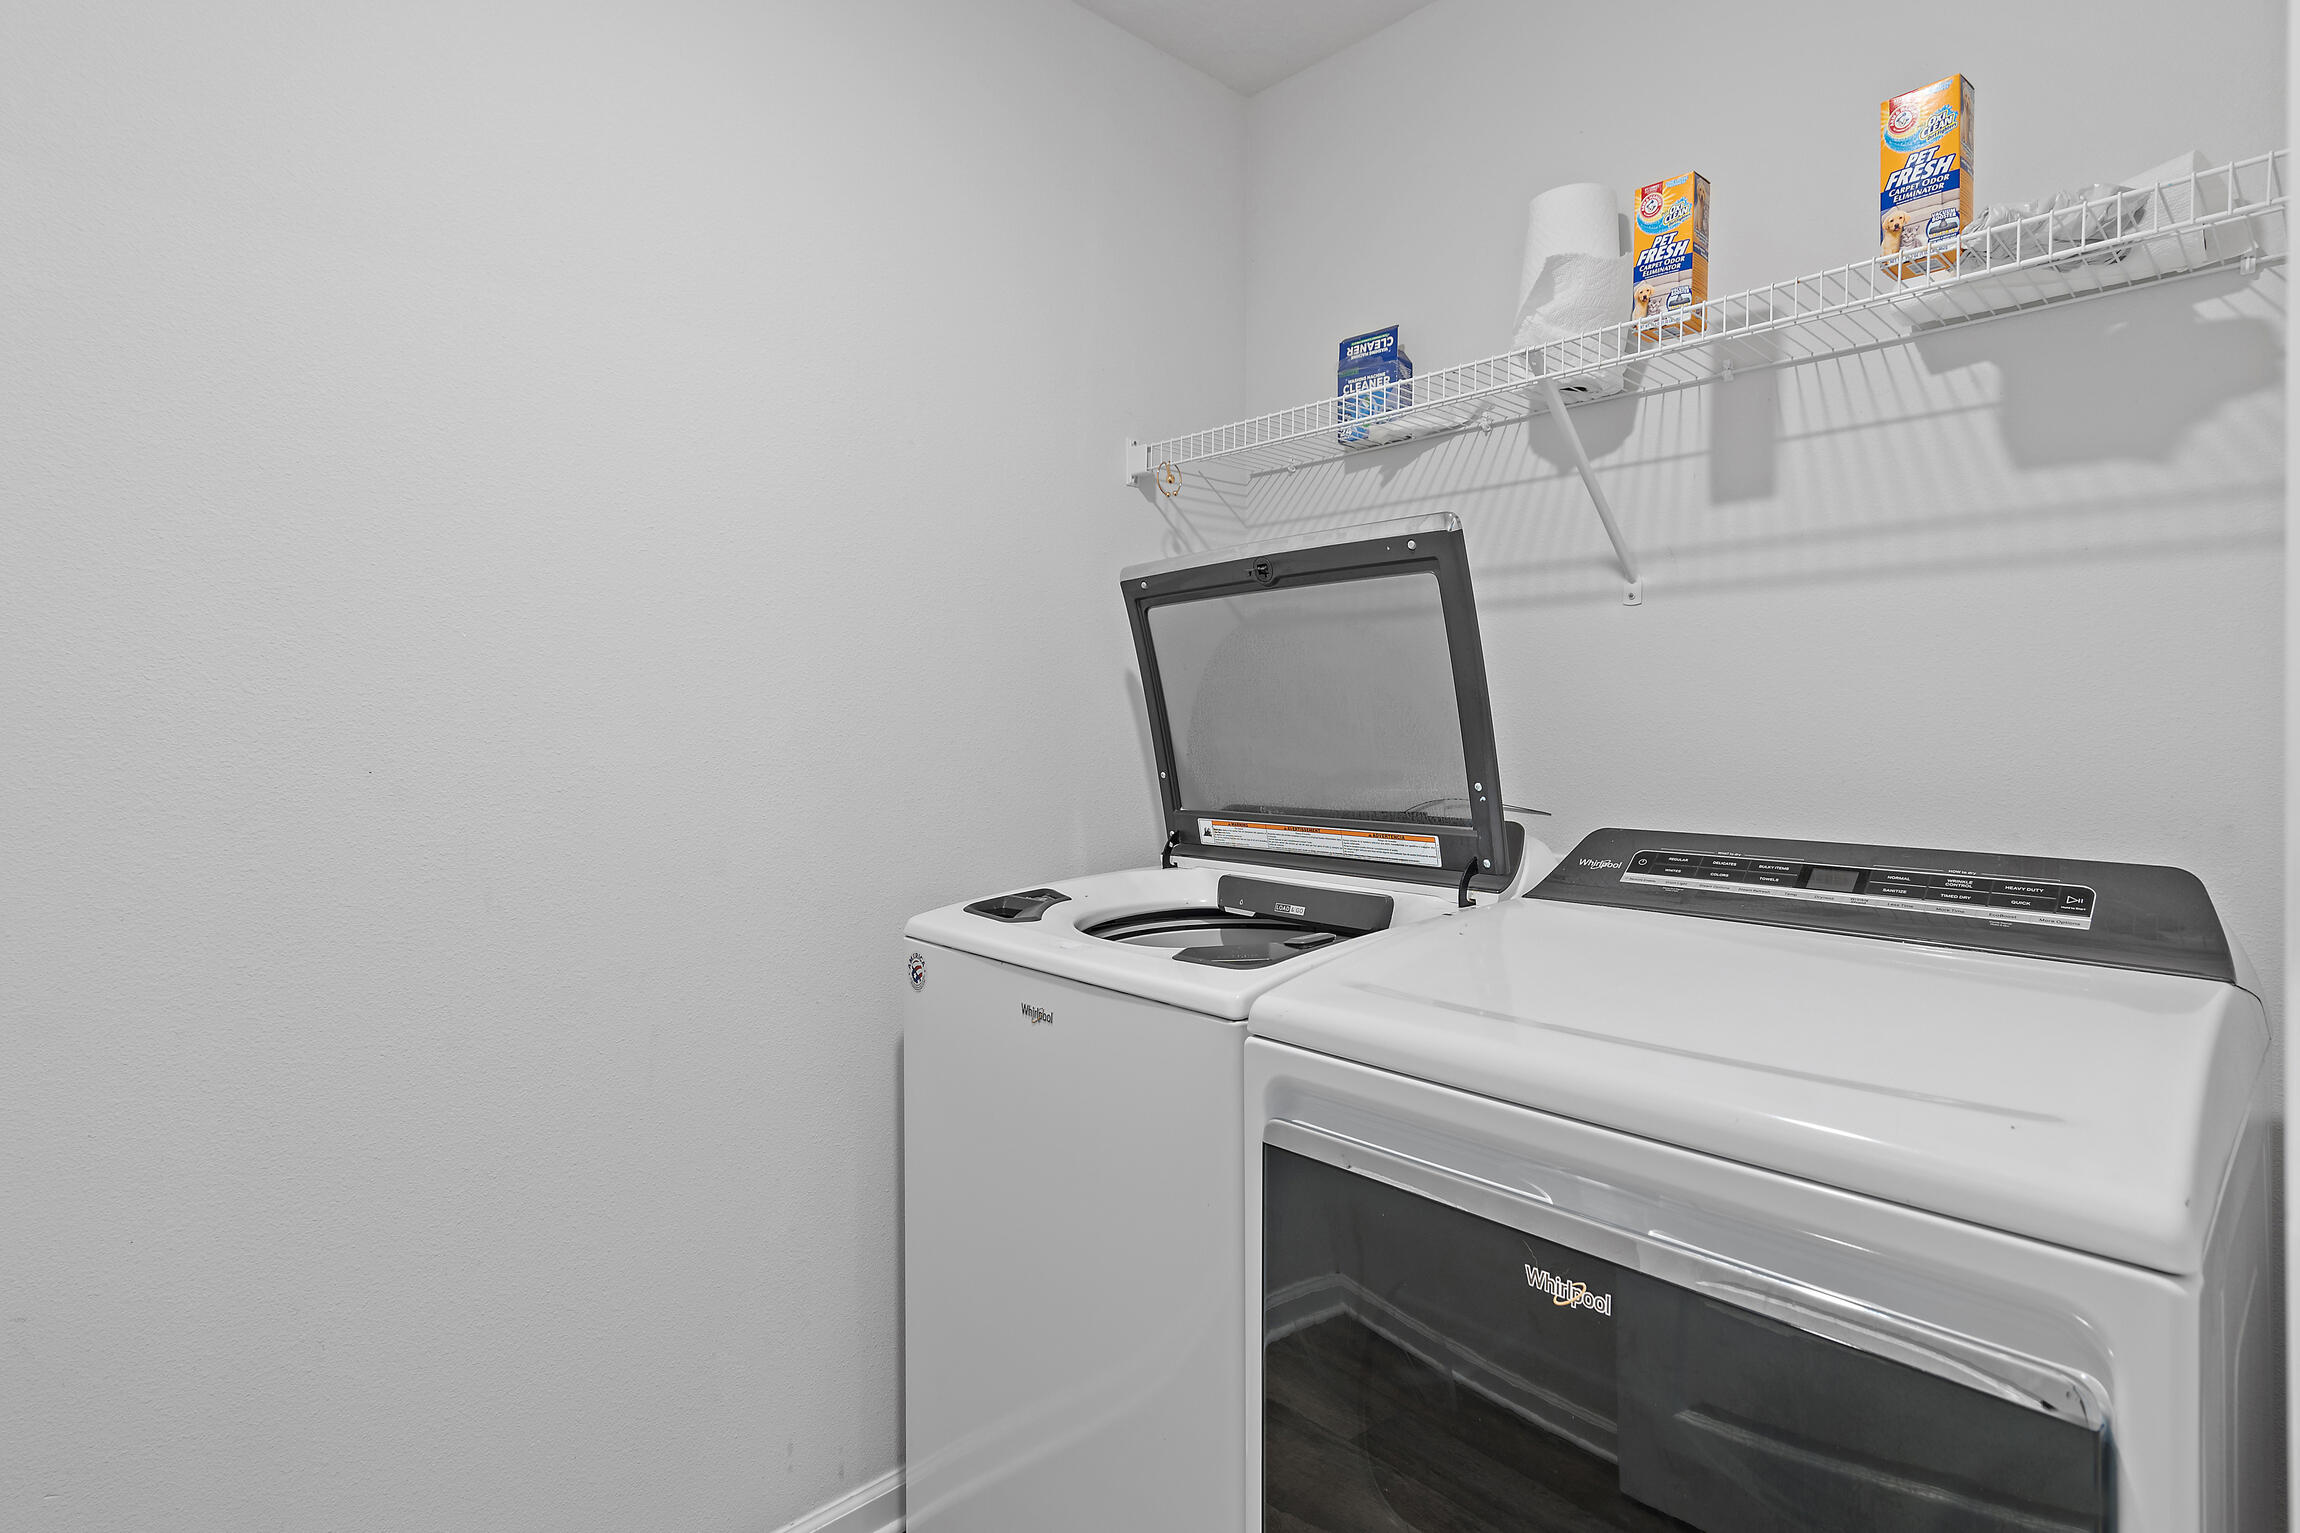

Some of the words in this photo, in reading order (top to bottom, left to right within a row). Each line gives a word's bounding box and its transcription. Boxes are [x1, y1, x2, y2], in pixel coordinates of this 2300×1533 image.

[1921, 114, 1955, 139] CLEAN
[1928, 111, 1947, 126] OXI
[1905, 146, 1940, 168] PET
[1885, 154, 1956, 191] FRESH
[1889, 182, 1921, 197] CARPET
[1922, 173, 1950, 187] ODOR
[1893, 182, 1945, 203] ELIMINATOR
[1664, 206, 1688, 224] CLEAN
[1652, 231, 1678, 248] PET
[1636, 239, 1690, 267] FRESH
[1639, 260, 1663, 272] CARPET
[1664, 256, 1686, 266] ODOR
[1642, 262, 1682, 277] ELIMINATOR
[1346, 336, 1394, 357] CLEANER
[1343, 376, 1391, 394] CLEANER
[1579, 858, 1623, 870] Whirlpool
[1275, 903, 1290, 912] LOAD
[1020, 1002, 1054, 1024] Whirlpool
[1524, 1263, 1612, 1317] Whirlpool
